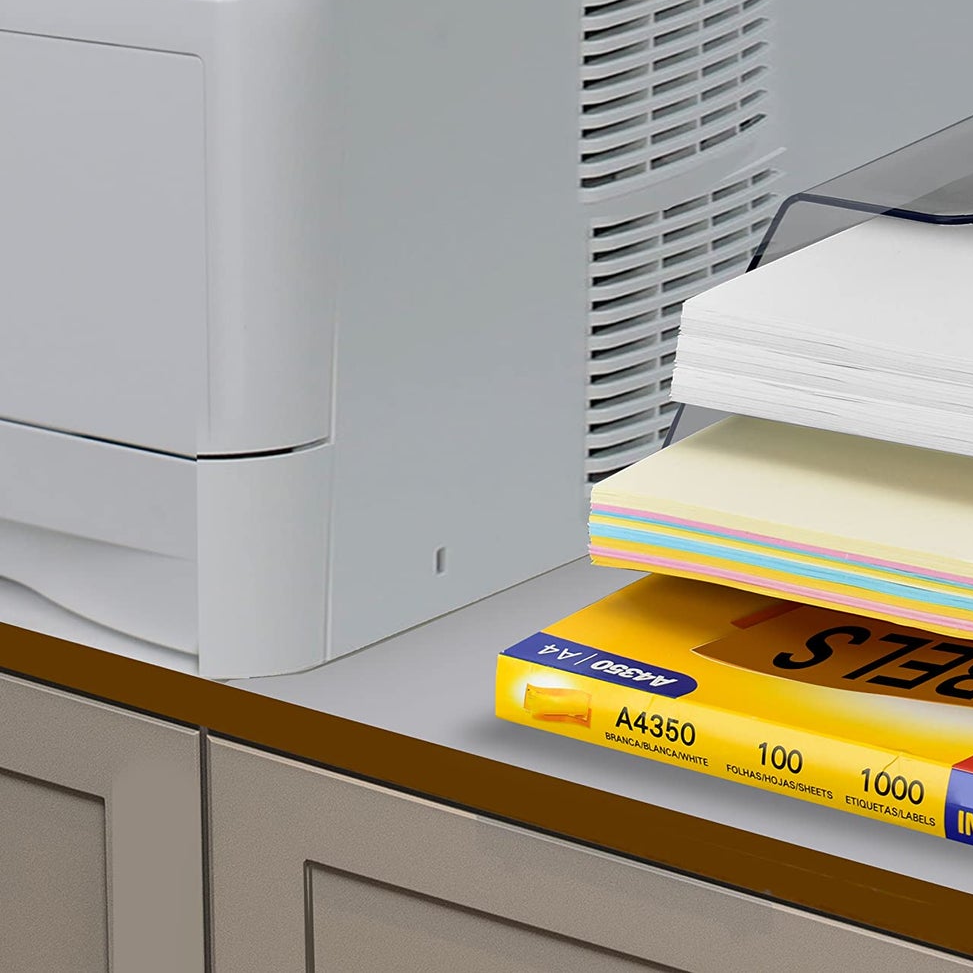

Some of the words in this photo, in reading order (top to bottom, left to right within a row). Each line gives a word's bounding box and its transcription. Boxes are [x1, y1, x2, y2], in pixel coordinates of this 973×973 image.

[537, 644, 582, 660] A4
[590, 660, 678, 687] A4350
[615, 706, 696, 747] A4350
[604, 732, 710, 767] BRANCA/BLANCA/WHITE
[758, 741, 804, 775] 100
[725, 763, 834, 800] FOLHAS/HOJAS/SHEETS
[861, 767, 925, 806] 1000
[845, 795, 937, 827] ETIQUETAS/LABELS
